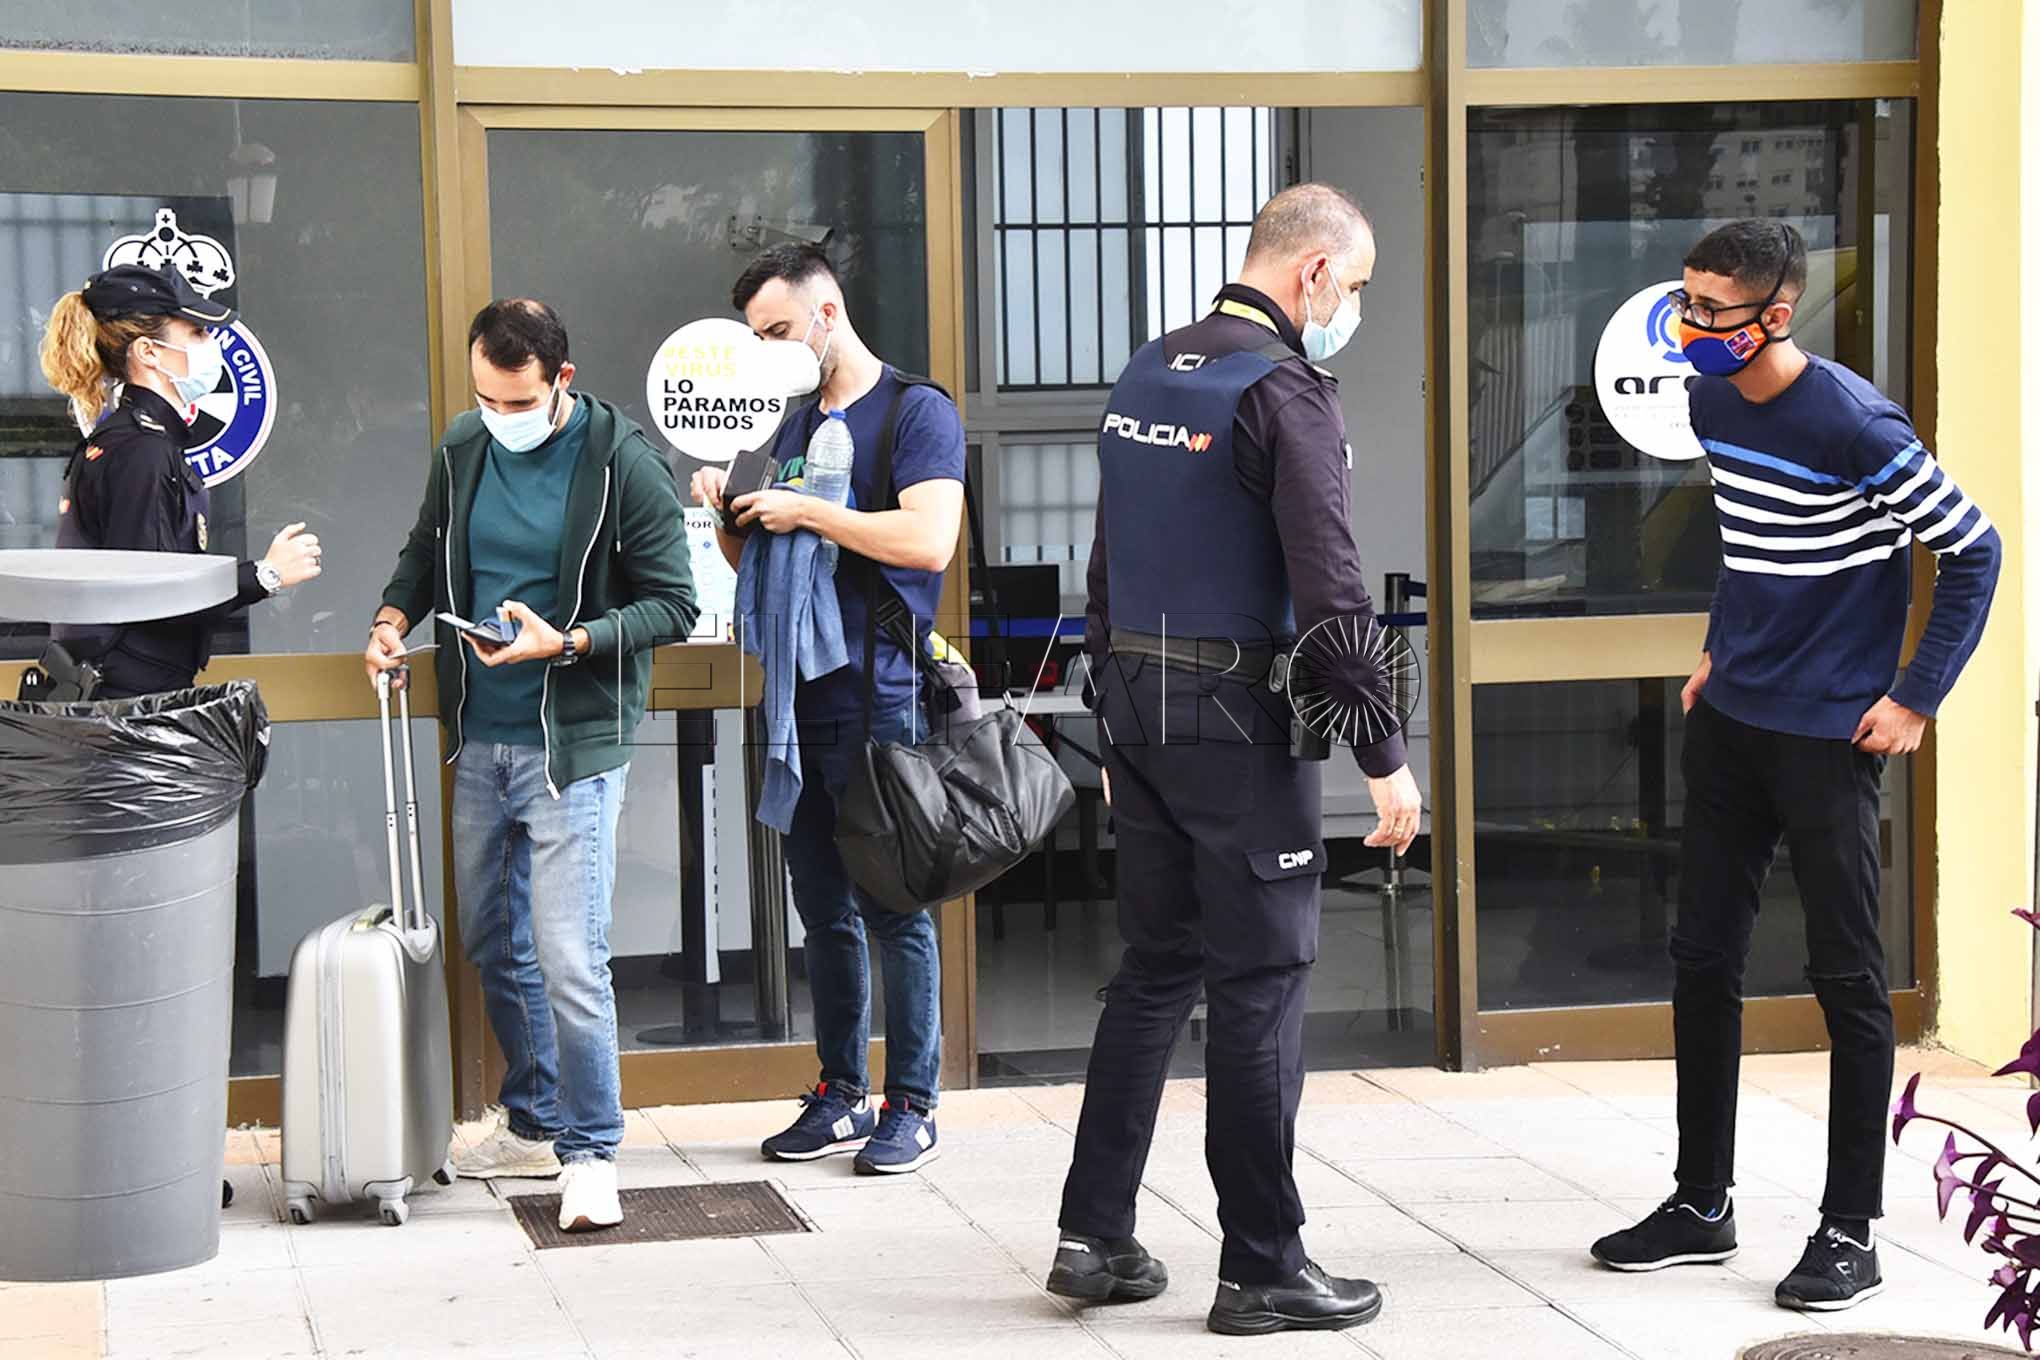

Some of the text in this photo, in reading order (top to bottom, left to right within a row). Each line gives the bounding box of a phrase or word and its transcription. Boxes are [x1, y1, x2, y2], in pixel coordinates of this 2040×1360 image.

[232, 349, 262, 405] CIVIL
[664, 362, 737, 377] VIRUS
[663, 378, 694, 394] LO
[663, 397, 781, 413] PARAMOS
[663, 414, 754, 430] UNIDOS
[1102, 413, 1191, 449] POLICIA
[1278, 849, 1314, 870] CNP
